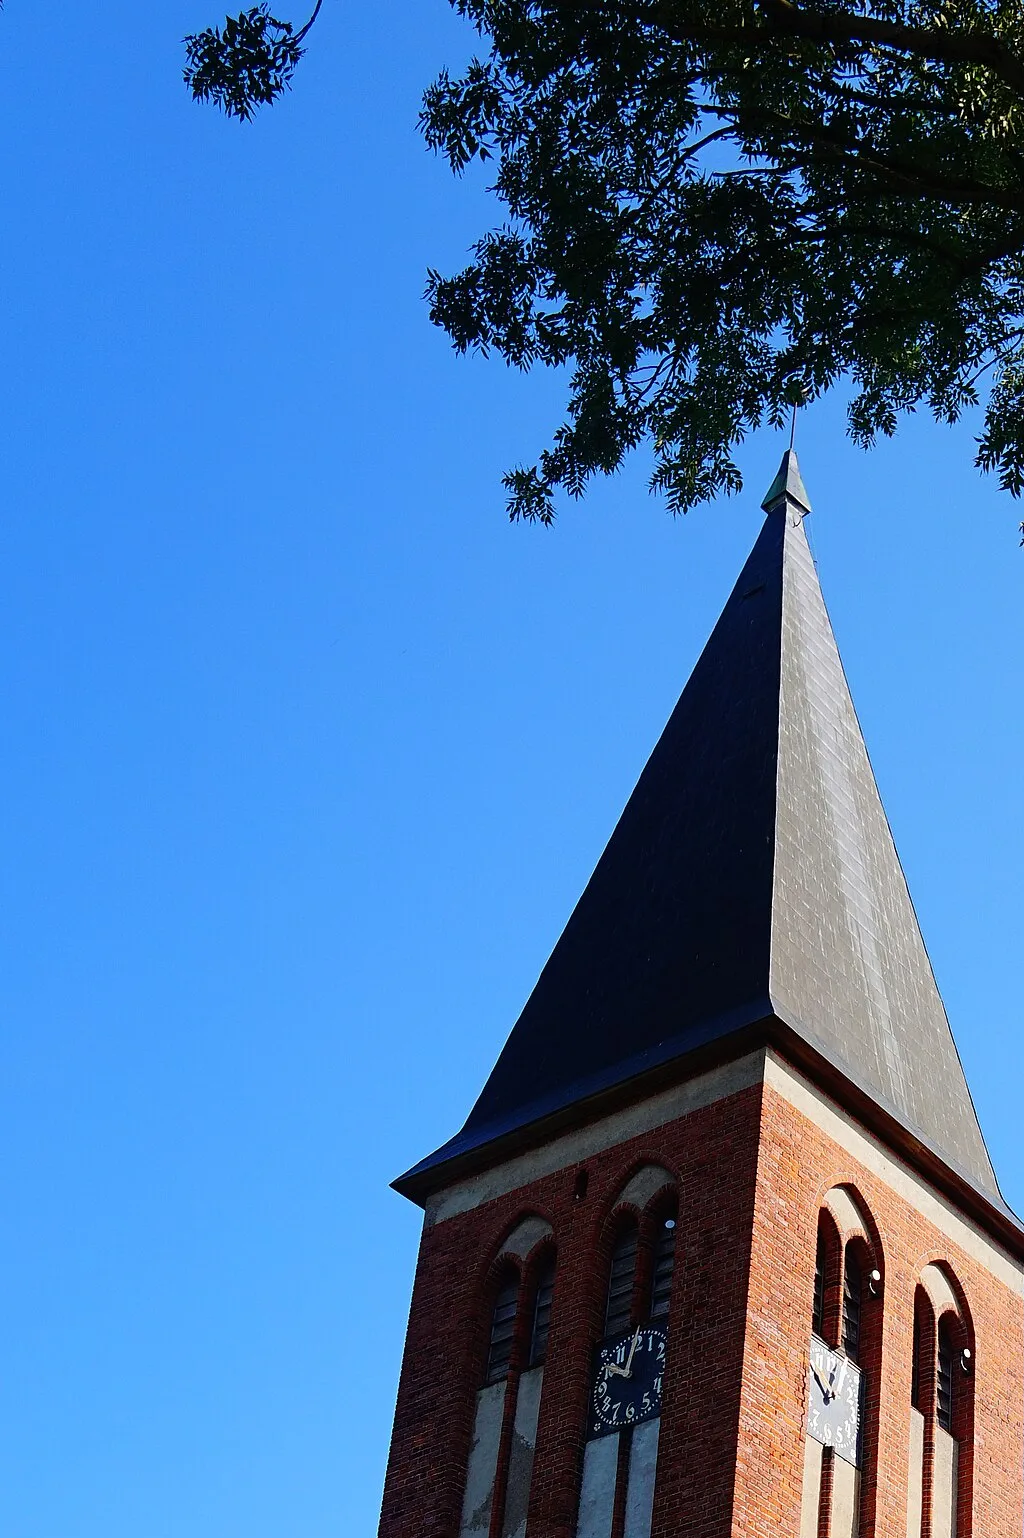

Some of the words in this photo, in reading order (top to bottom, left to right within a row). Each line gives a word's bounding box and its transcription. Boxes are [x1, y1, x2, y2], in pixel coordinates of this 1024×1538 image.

[648, 1335, 653, 1352] 1
[656, 1342, 665, 1361] 2
[616, 1345, 625, 1364] 11
[598, 1381, 608, 1398] 9
[653, 1377, 662, 1393] 4
[602, 1396, 611, 1412] 8
[641, 1391, 650, 1410] 5
[847, 1386, 854, 1405] 2
[612, 1401, 621, 1421] 7
[625, 1401, 635, 1419] 6
[812, 1408, 820, 1427] 7
[850, 1406, 857, 1425] 3
[824, 1422, 832, 1441] 6
[835, 1425, 843, 1443] 5
[845, 1420, 851, 1439] 4
